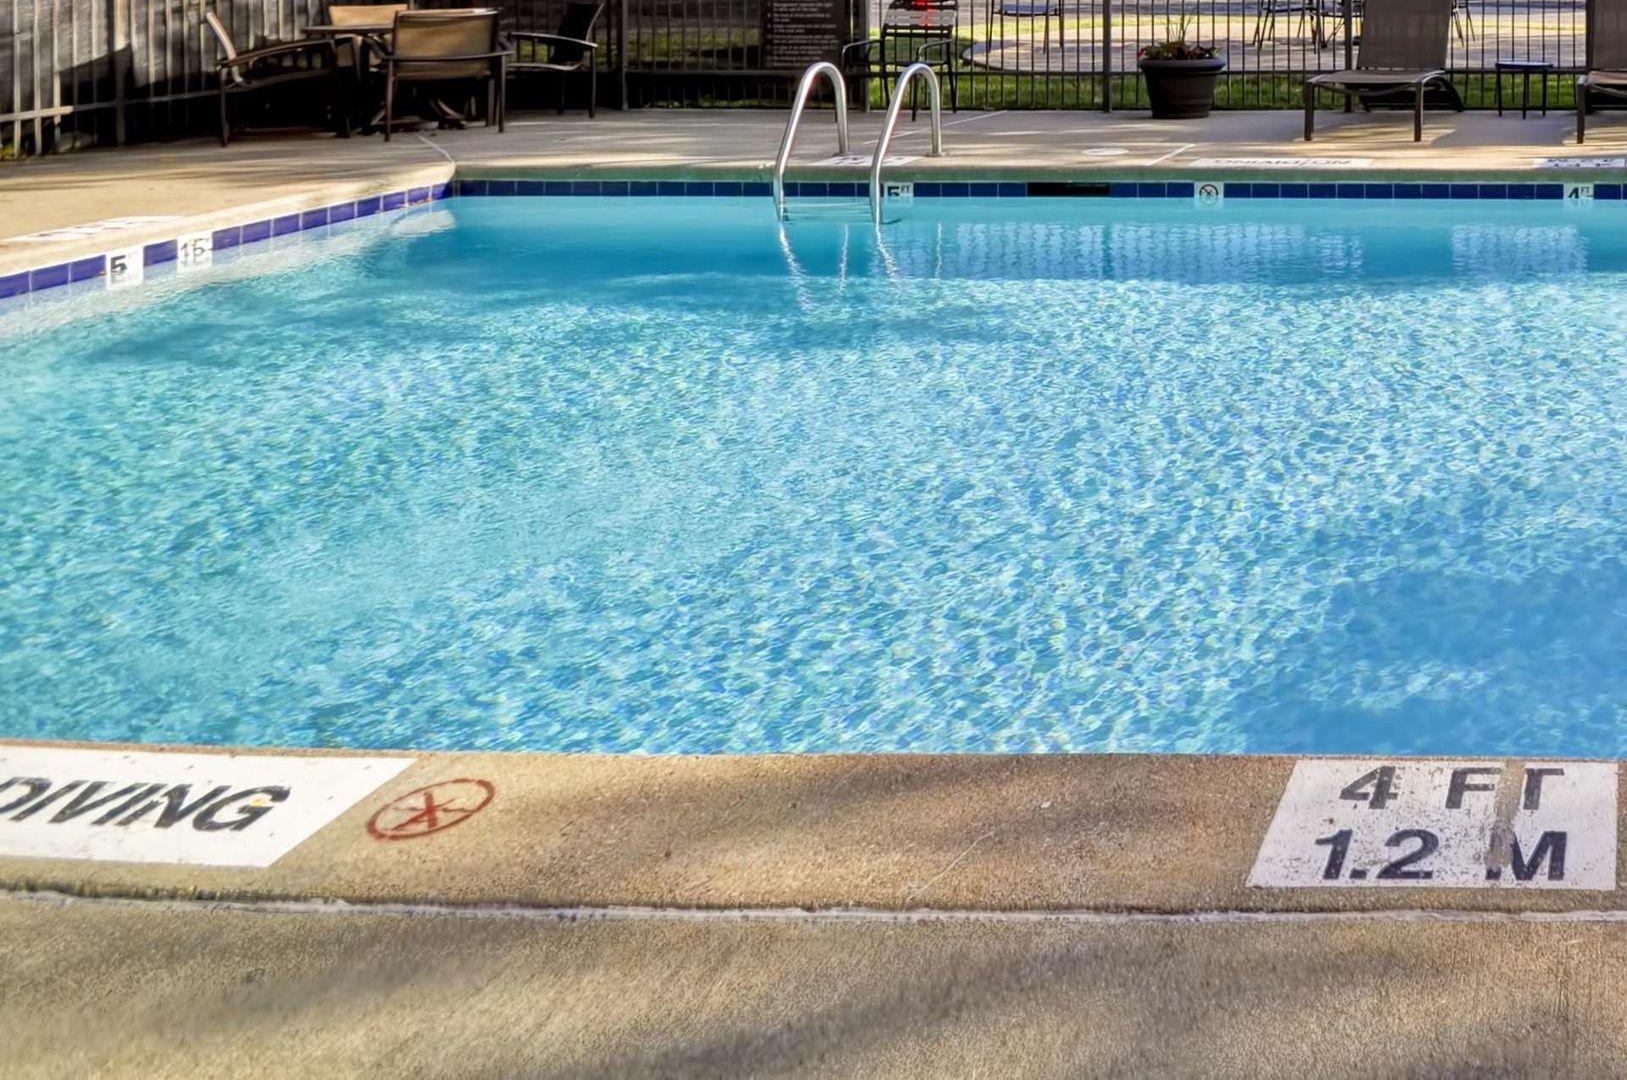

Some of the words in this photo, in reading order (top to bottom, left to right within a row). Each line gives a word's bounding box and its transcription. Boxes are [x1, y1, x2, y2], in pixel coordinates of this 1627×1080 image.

[110, 255, 127, 273] 5
[1339, 765, 1399, 810] 4
[1445, 766, 1565, 811] FT
[1315, 829, 1439, 880] 1.2
[1484, 830, 1568, 881] M
